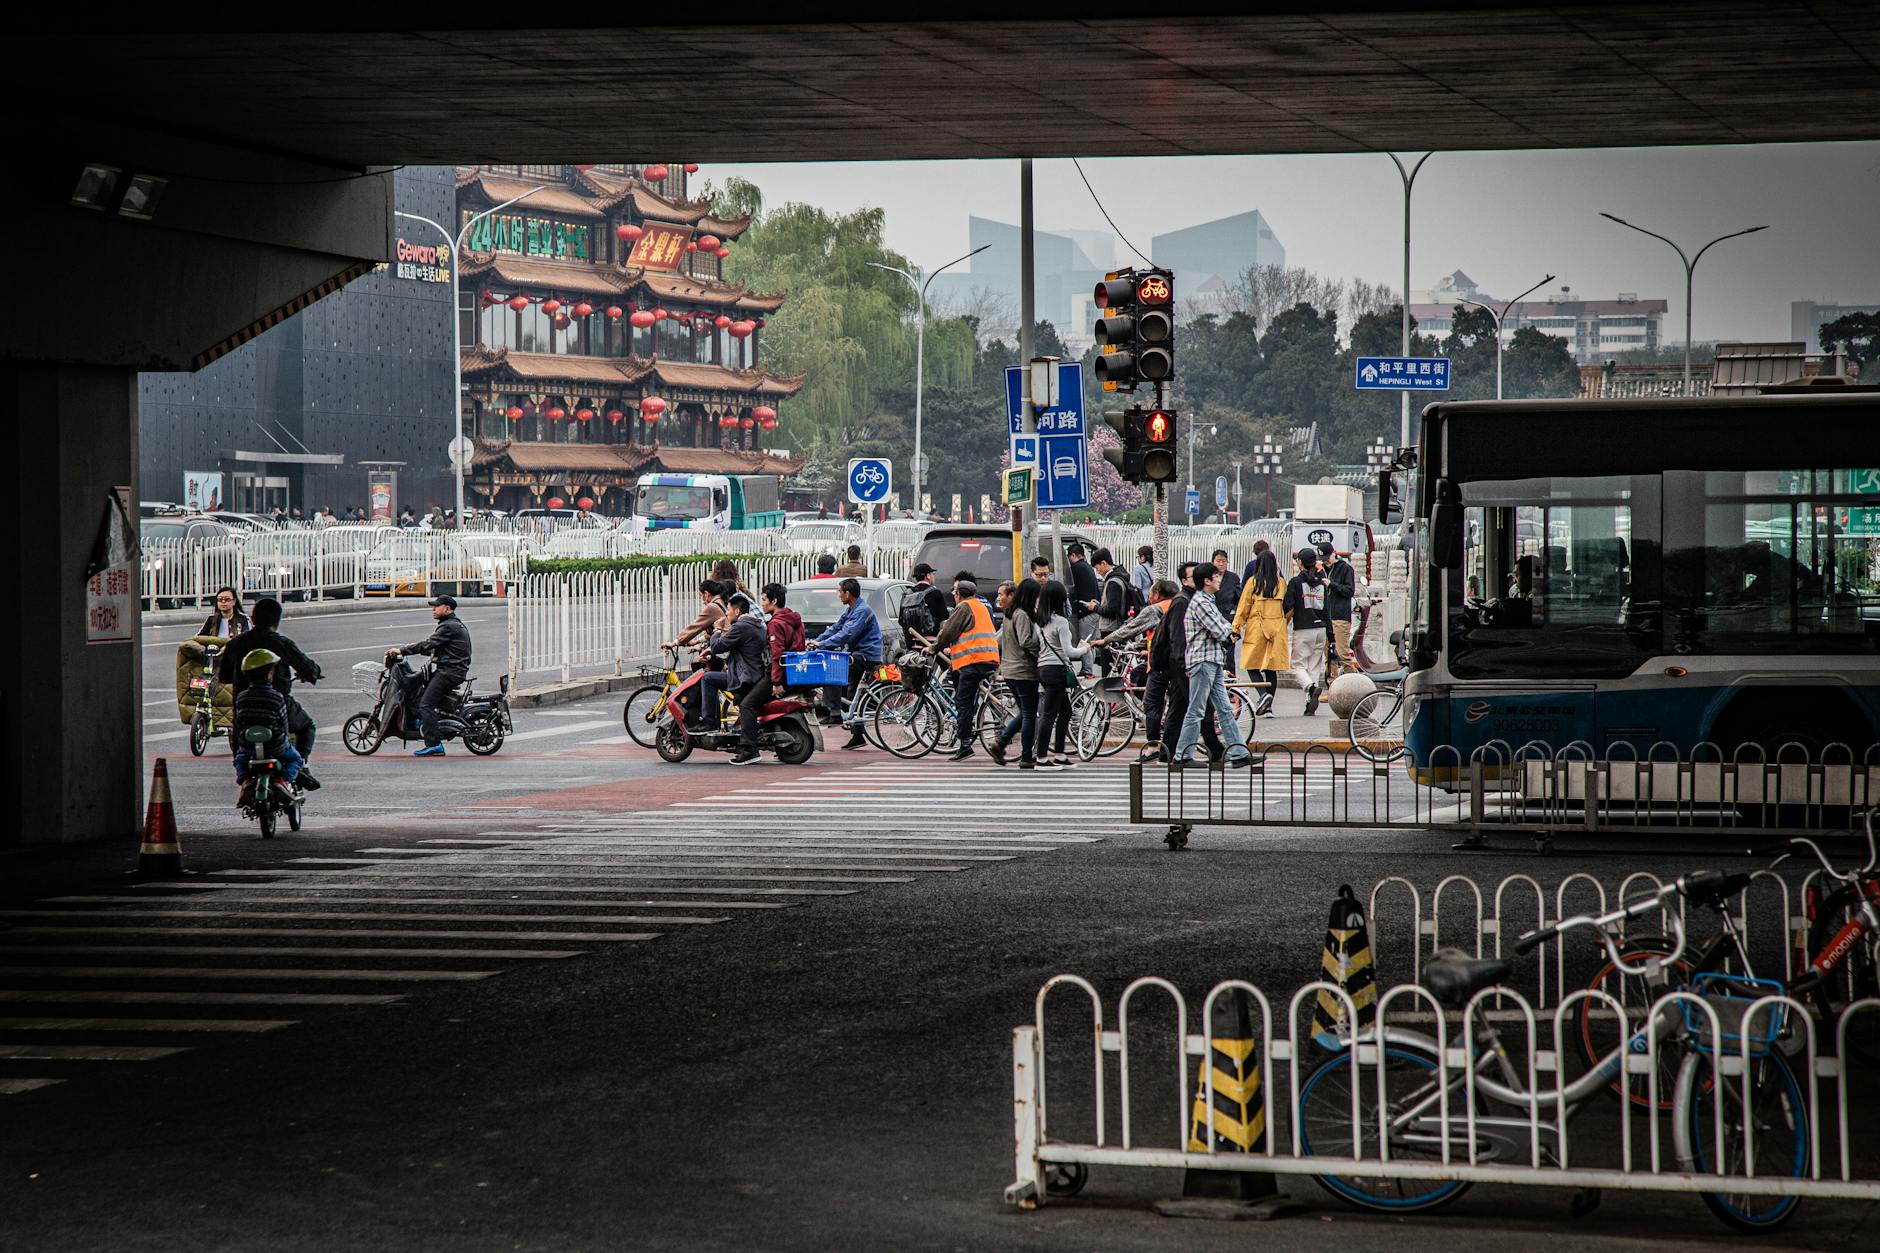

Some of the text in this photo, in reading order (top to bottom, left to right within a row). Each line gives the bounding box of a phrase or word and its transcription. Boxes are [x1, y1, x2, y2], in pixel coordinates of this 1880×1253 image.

[397, 238, 436, 264] Gewara
[1379, 362, 1445, 375] 和平里西街
[1379, 377, 1443, 386] HEPINGLI West St
[1828, 926, 1861, 964] mobike
